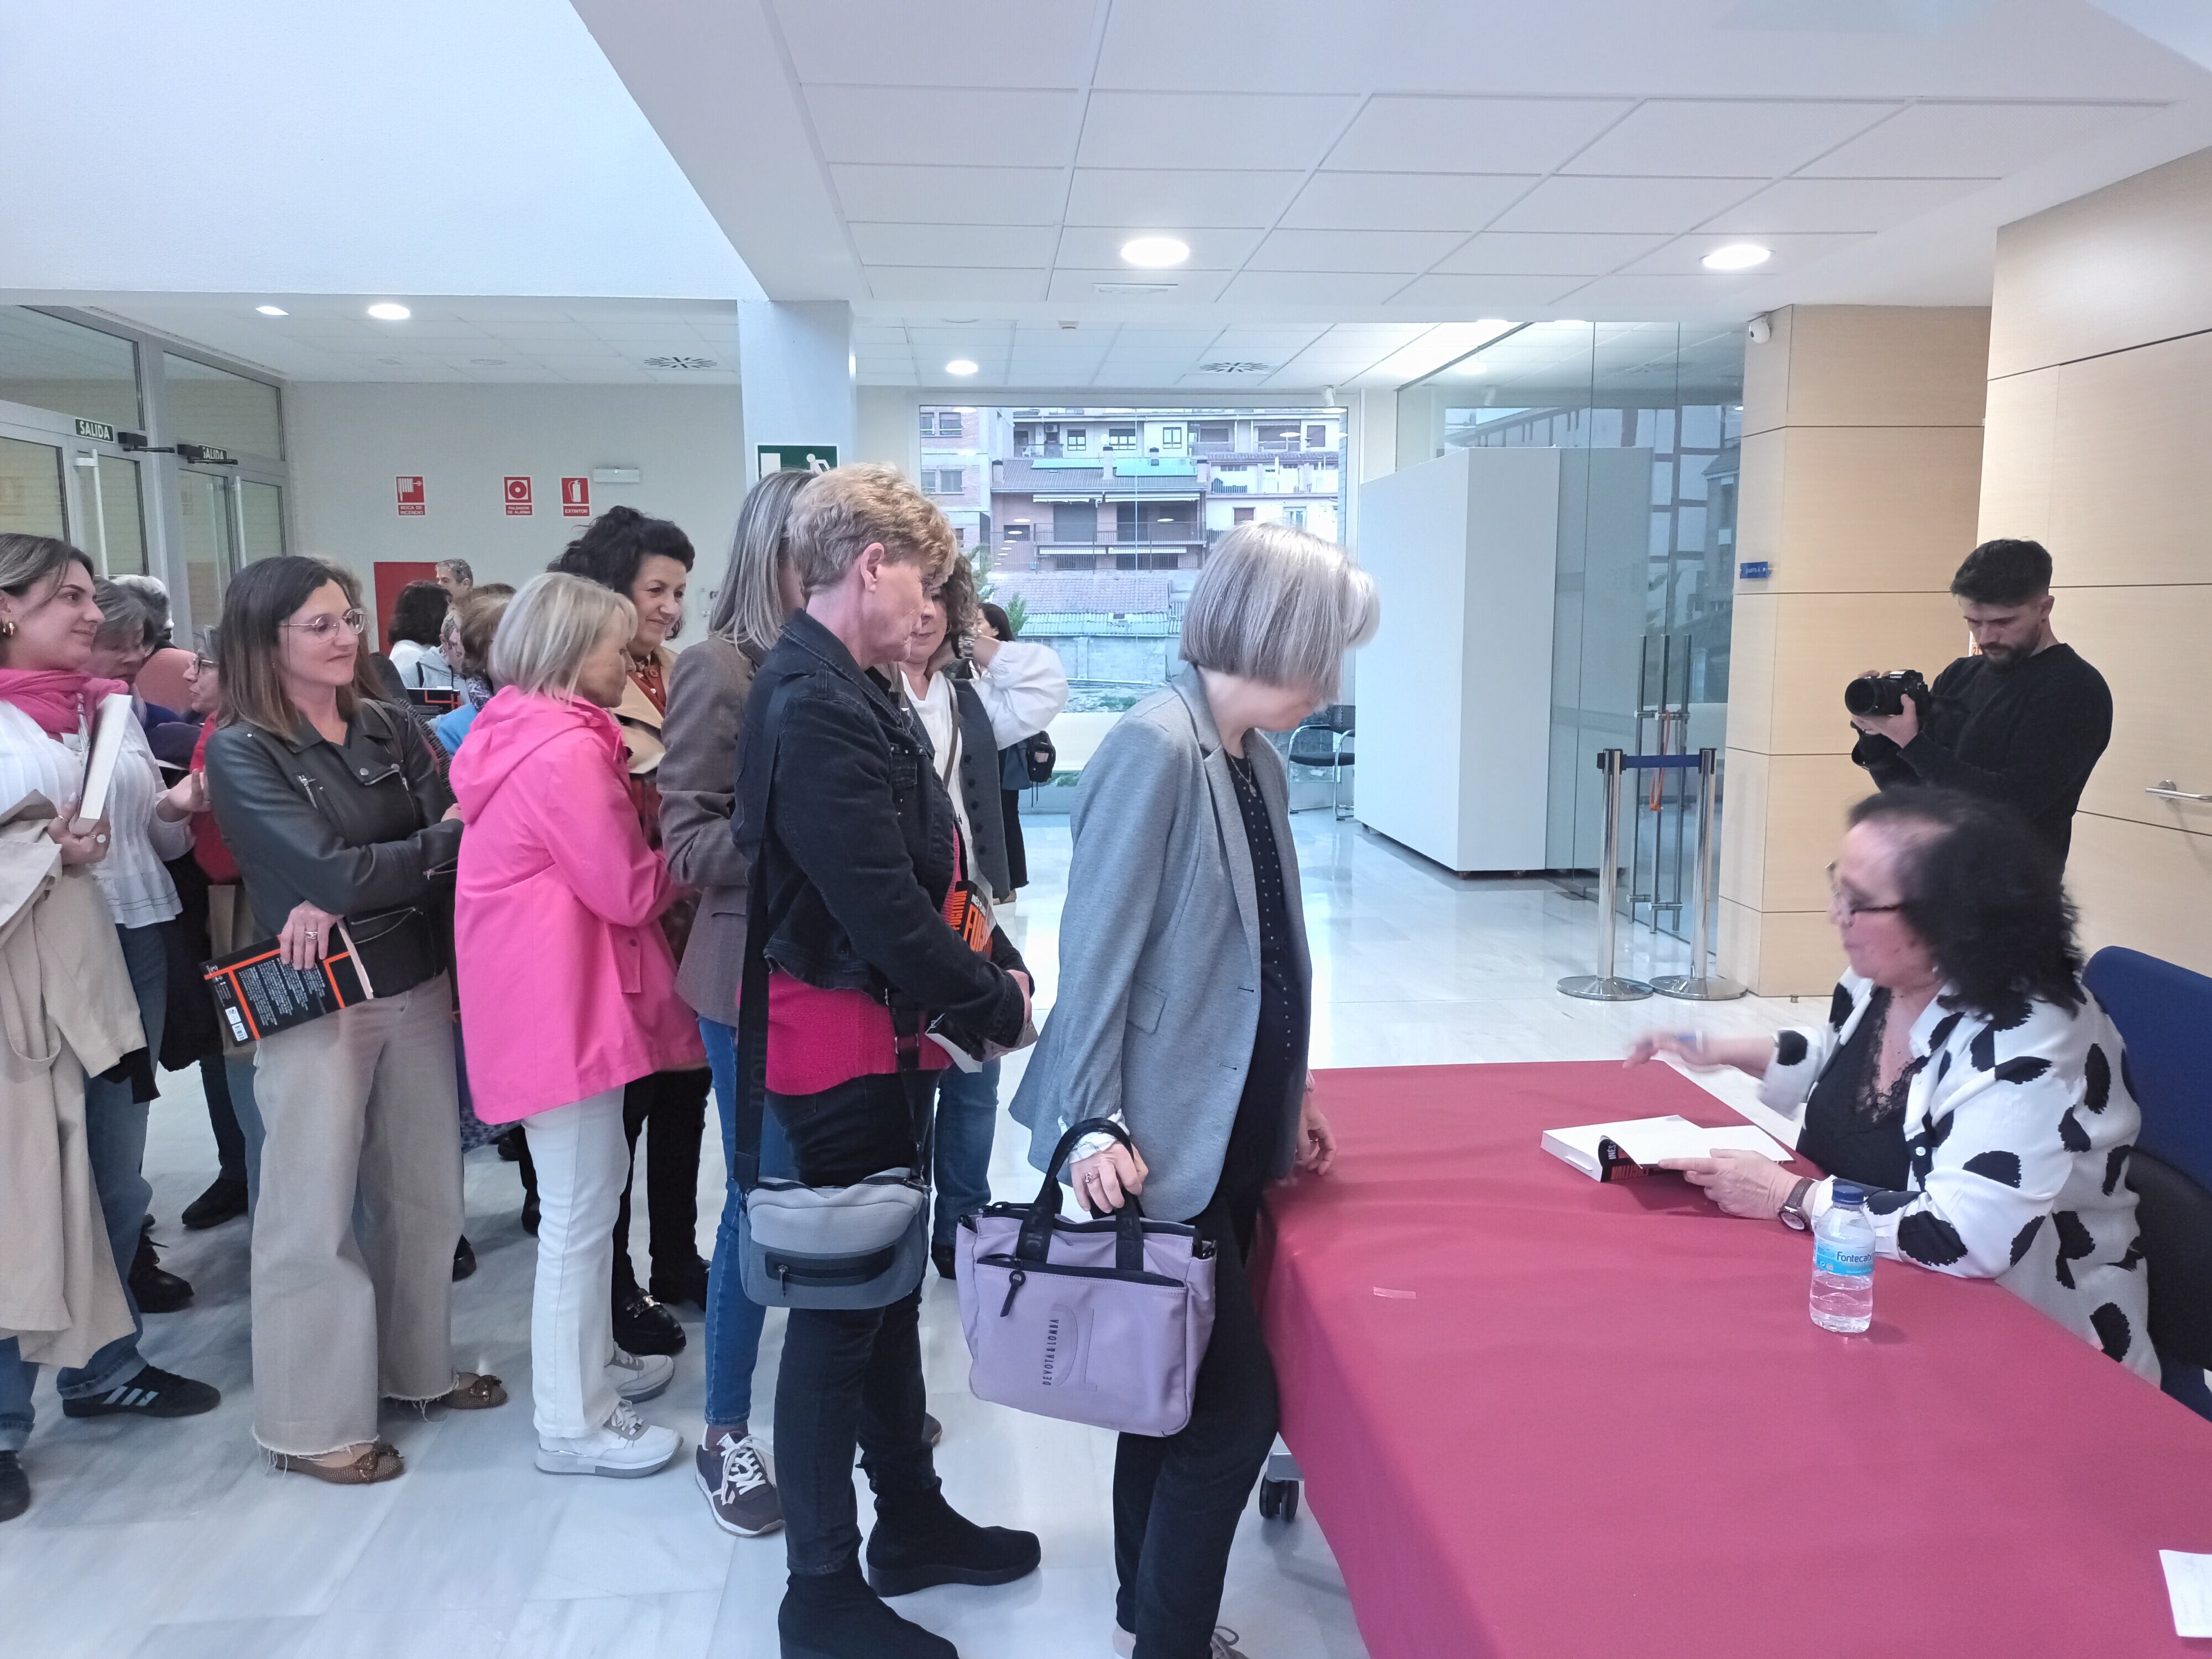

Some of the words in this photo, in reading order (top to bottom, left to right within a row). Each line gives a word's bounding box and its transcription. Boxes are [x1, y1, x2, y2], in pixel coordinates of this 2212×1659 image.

[80, 421, 110, 440] SALIDA
[1607, 1144, 1616, 1160] INÉS
[1047, 1319, 1059, 1345] LOMBA
[1042, 1355, 1055, 1386] DEVOTA
